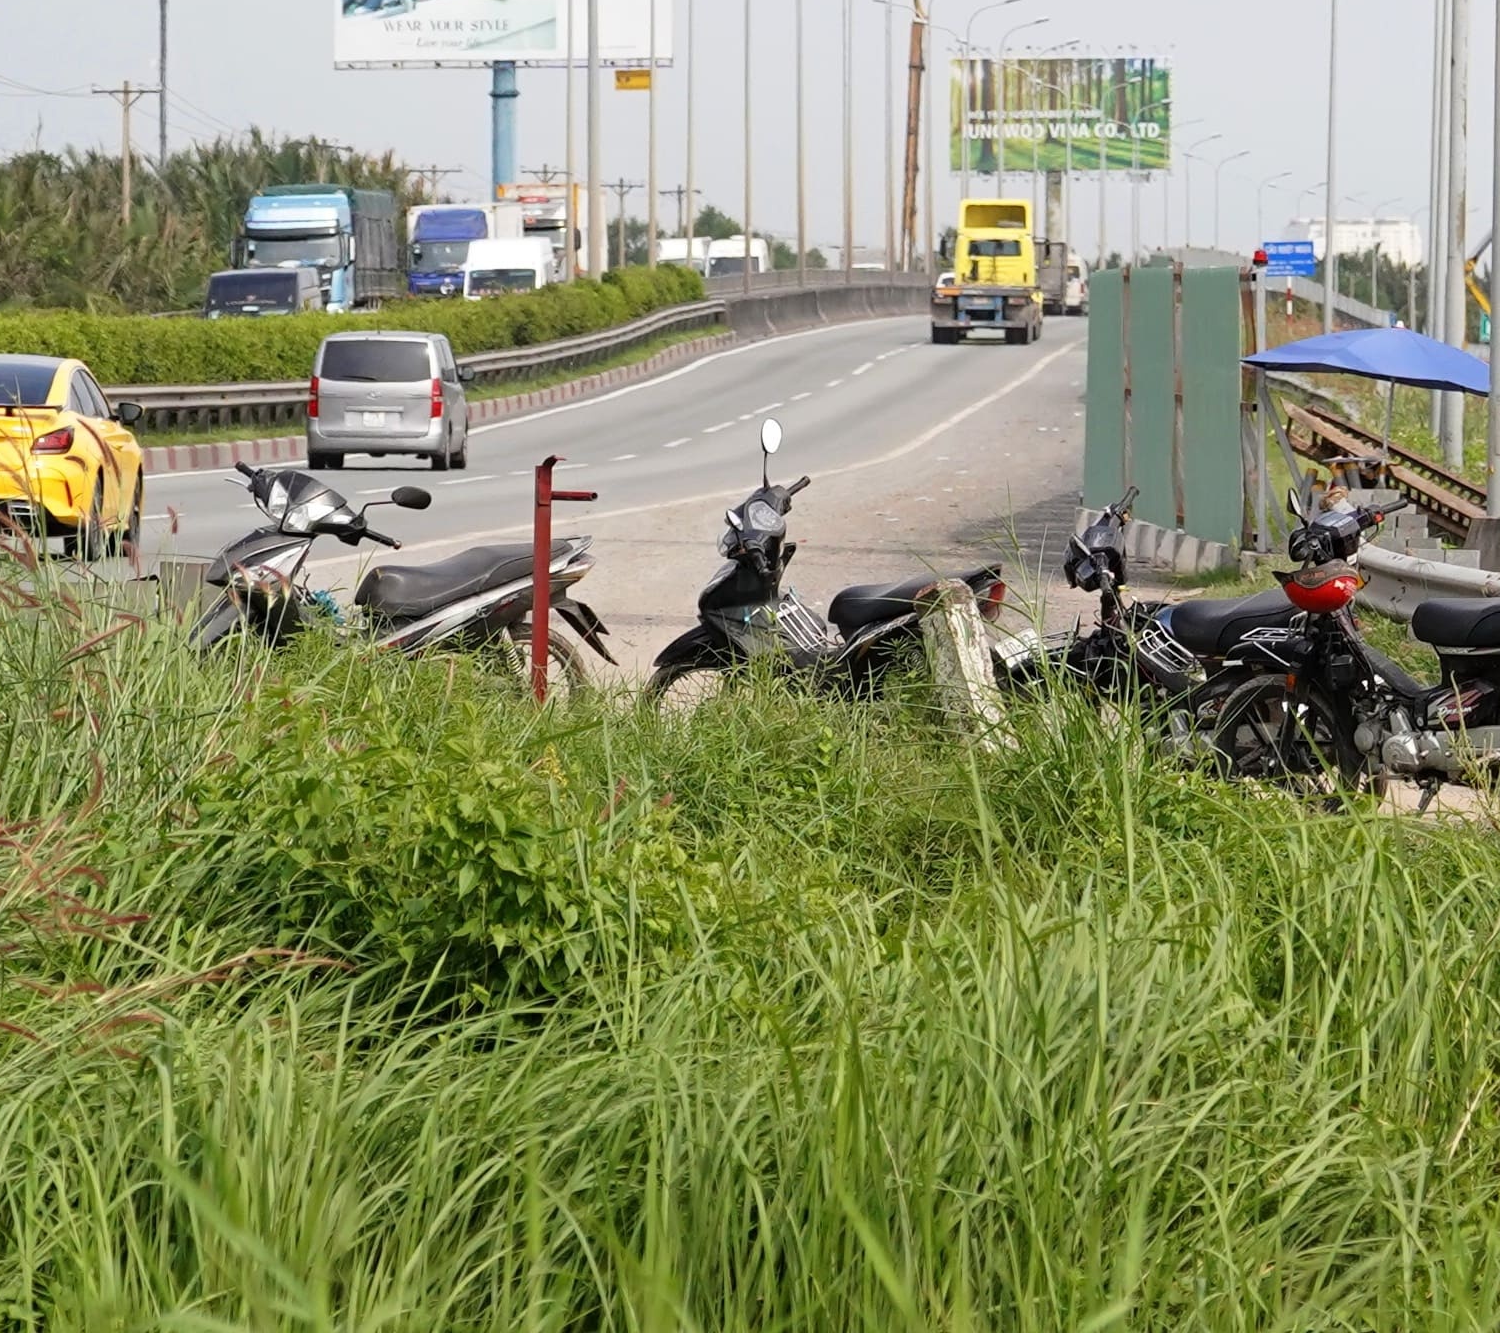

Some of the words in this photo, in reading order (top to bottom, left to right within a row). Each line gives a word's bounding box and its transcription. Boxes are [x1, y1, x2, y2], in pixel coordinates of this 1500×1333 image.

[383, 19, 421, 32] WEAR
[429, 19, 464, 32] YOUR
[470, 19, 510, 31] STYLE
[1130, 121, 1161, 139] LTD
